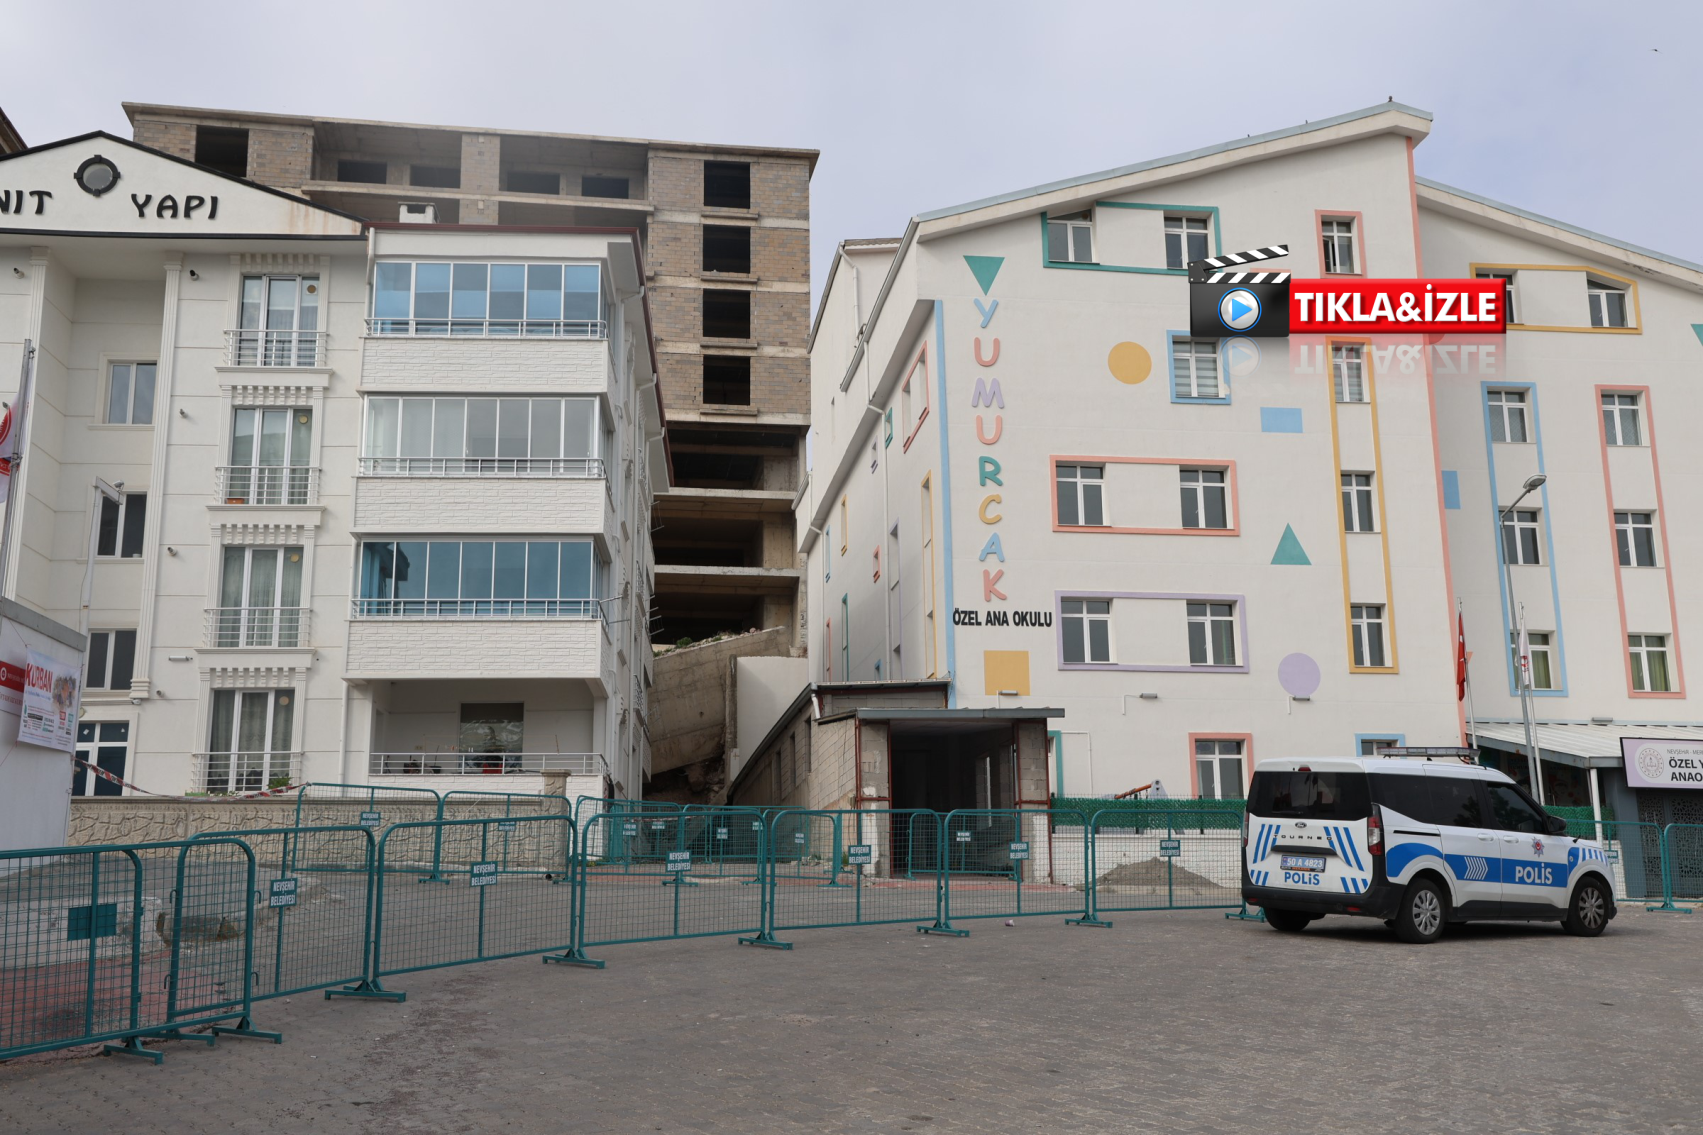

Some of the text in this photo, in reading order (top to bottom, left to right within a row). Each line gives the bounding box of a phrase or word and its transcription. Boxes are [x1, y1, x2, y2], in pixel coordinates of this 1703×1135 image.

[131, 193, 219, 219] YAPI
[972, 298, 1007, 602] YUMURCAK
[952, 607, 1053, 628] ÖZEL ANA OKULU
[25, 663, 53, 693] KURBAN
[1668, 756, 1698, 769] ÖZEL
[1670, 771, 1703, 782] ANAO
[1286, 858, 1323, 868] 50 A 4823
[1515, 862, 1553, 885] POLİS
